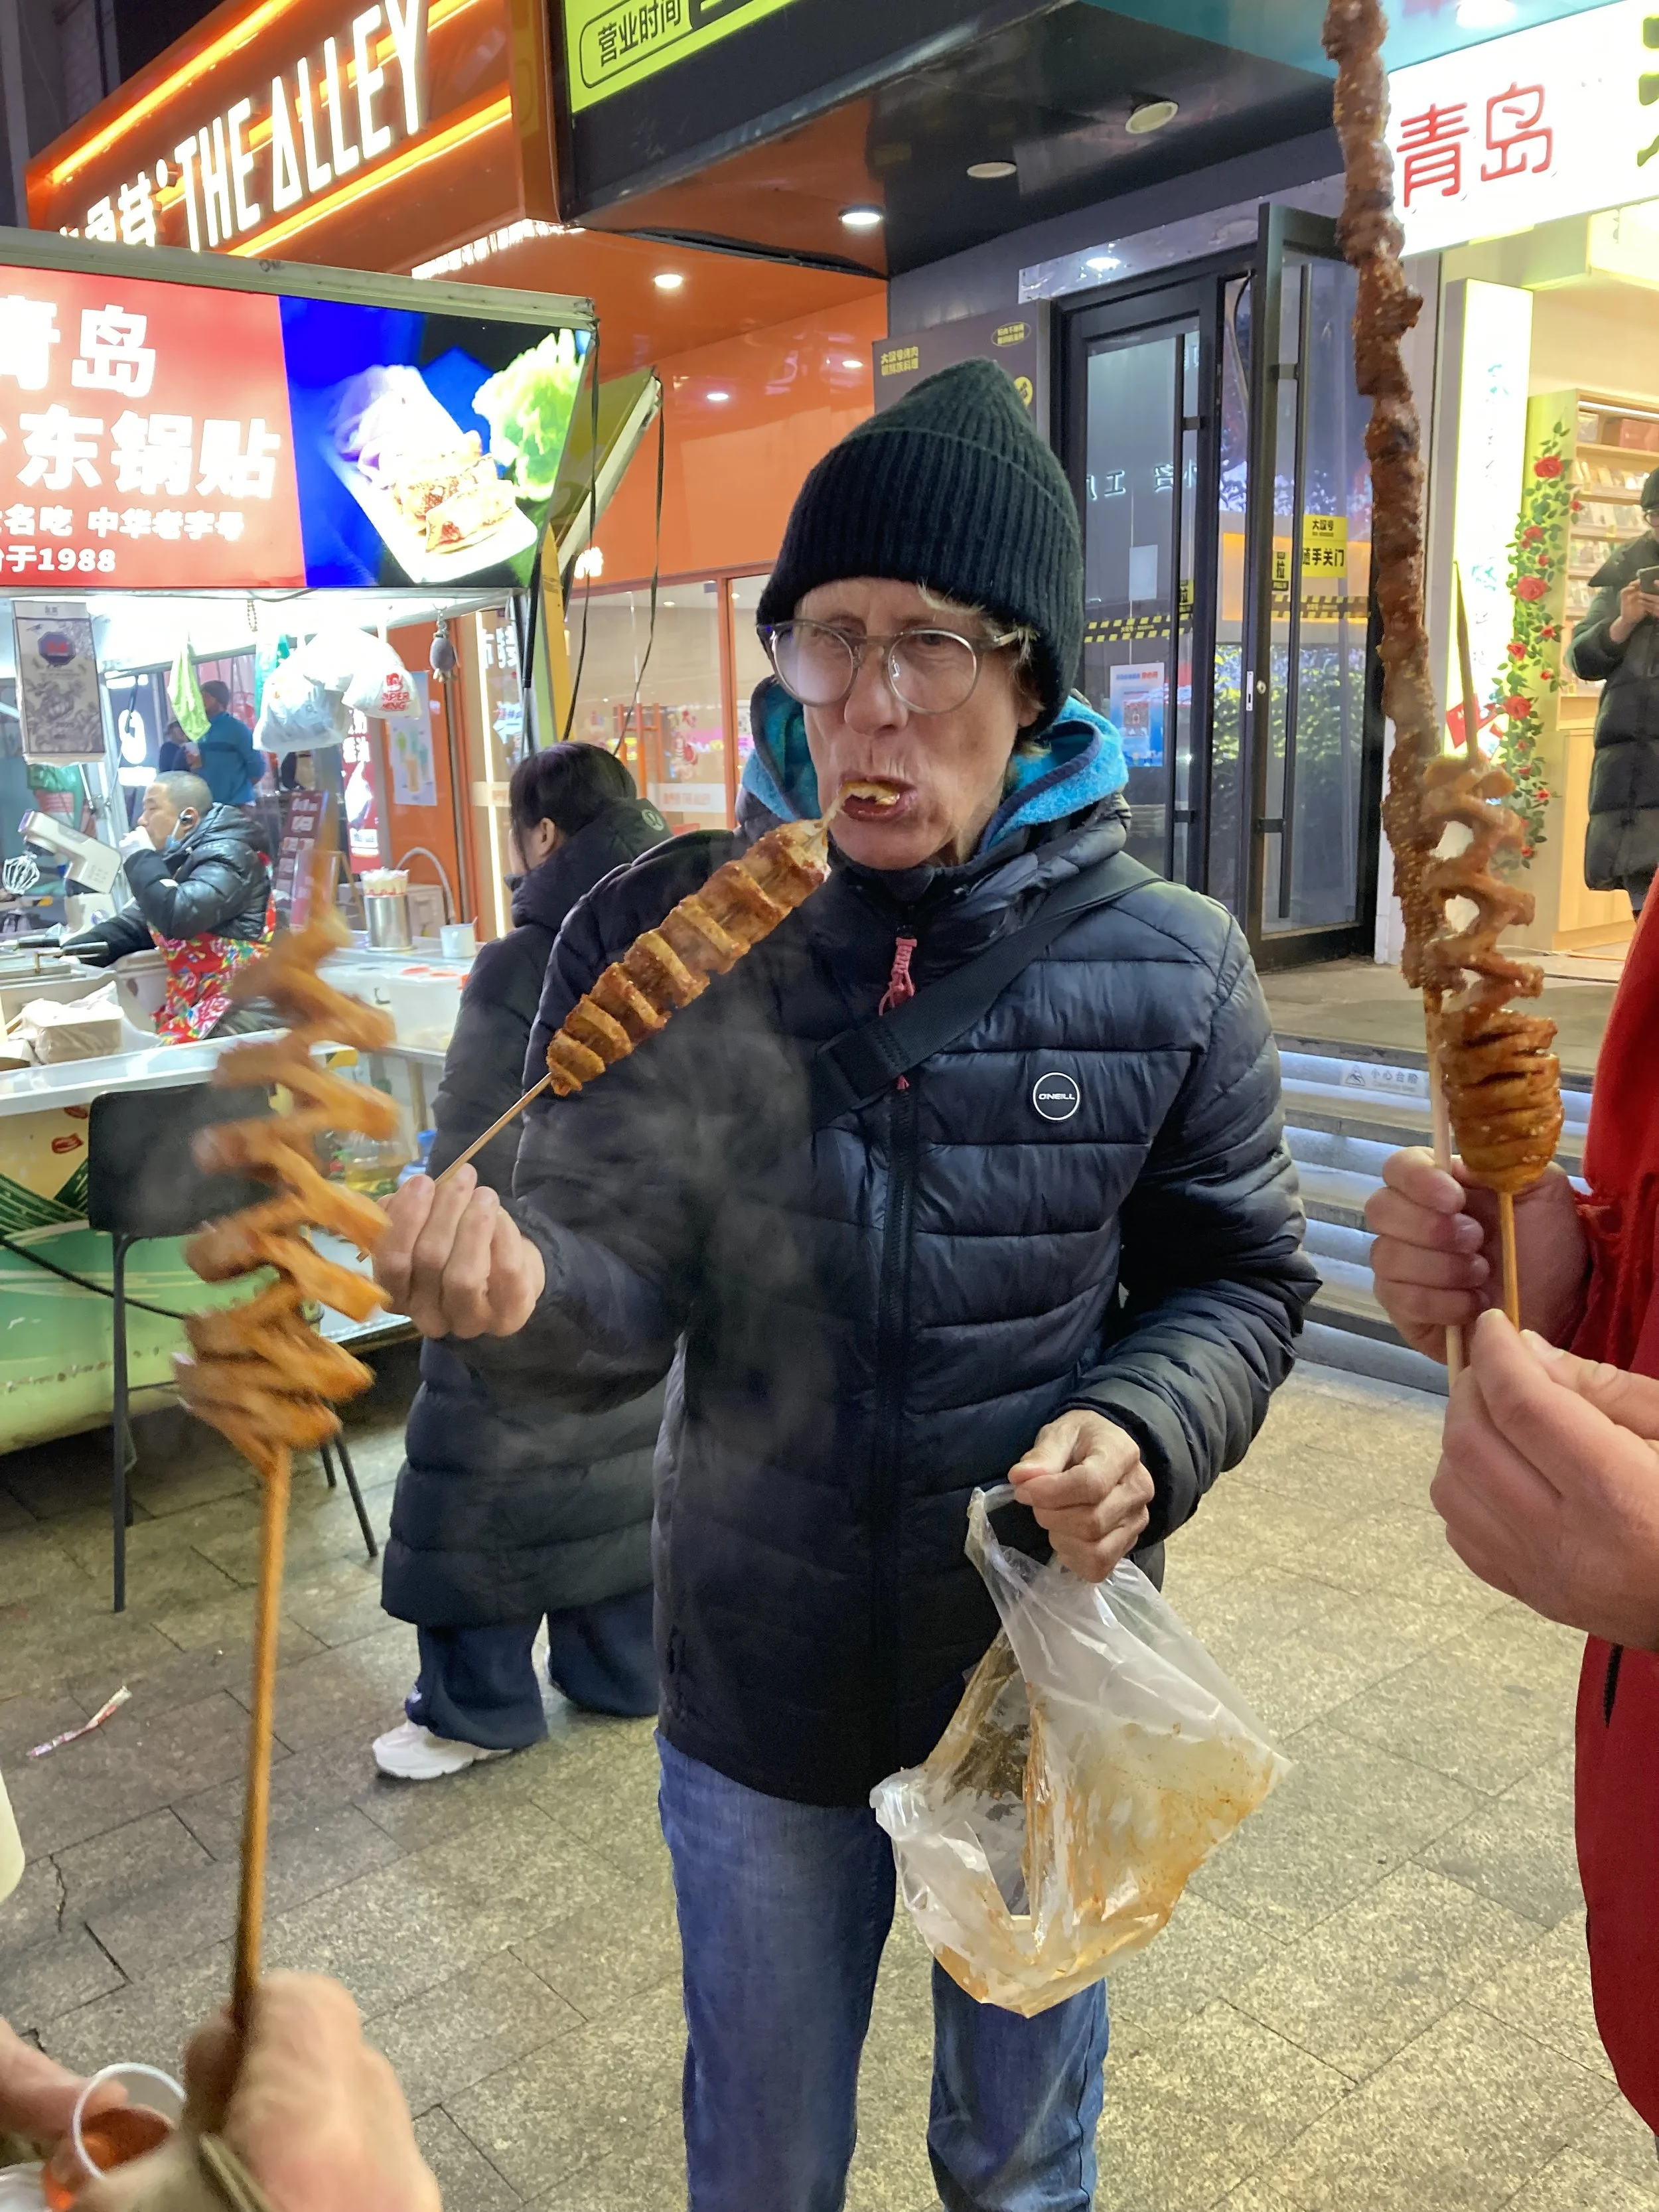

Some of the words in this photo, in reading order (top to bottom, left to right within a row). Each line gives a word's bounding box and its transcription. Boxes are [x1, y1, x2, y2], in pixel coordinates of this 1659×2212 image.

[598, 0, 681, 67] 营业时间
[174, 97, 261, 253] THE
[271, 0, 419, 212] ALLEY
[1396, 81, 1553, 208] 青岛
[0, 294, 156, 398] 青岛
[0, 403, 281, 498] 东锅贴
[0, 503, 73, 537] 名吃
[88, 506, 245, 542] 中华老字号
[0, 545, 116, 573] 于1988
